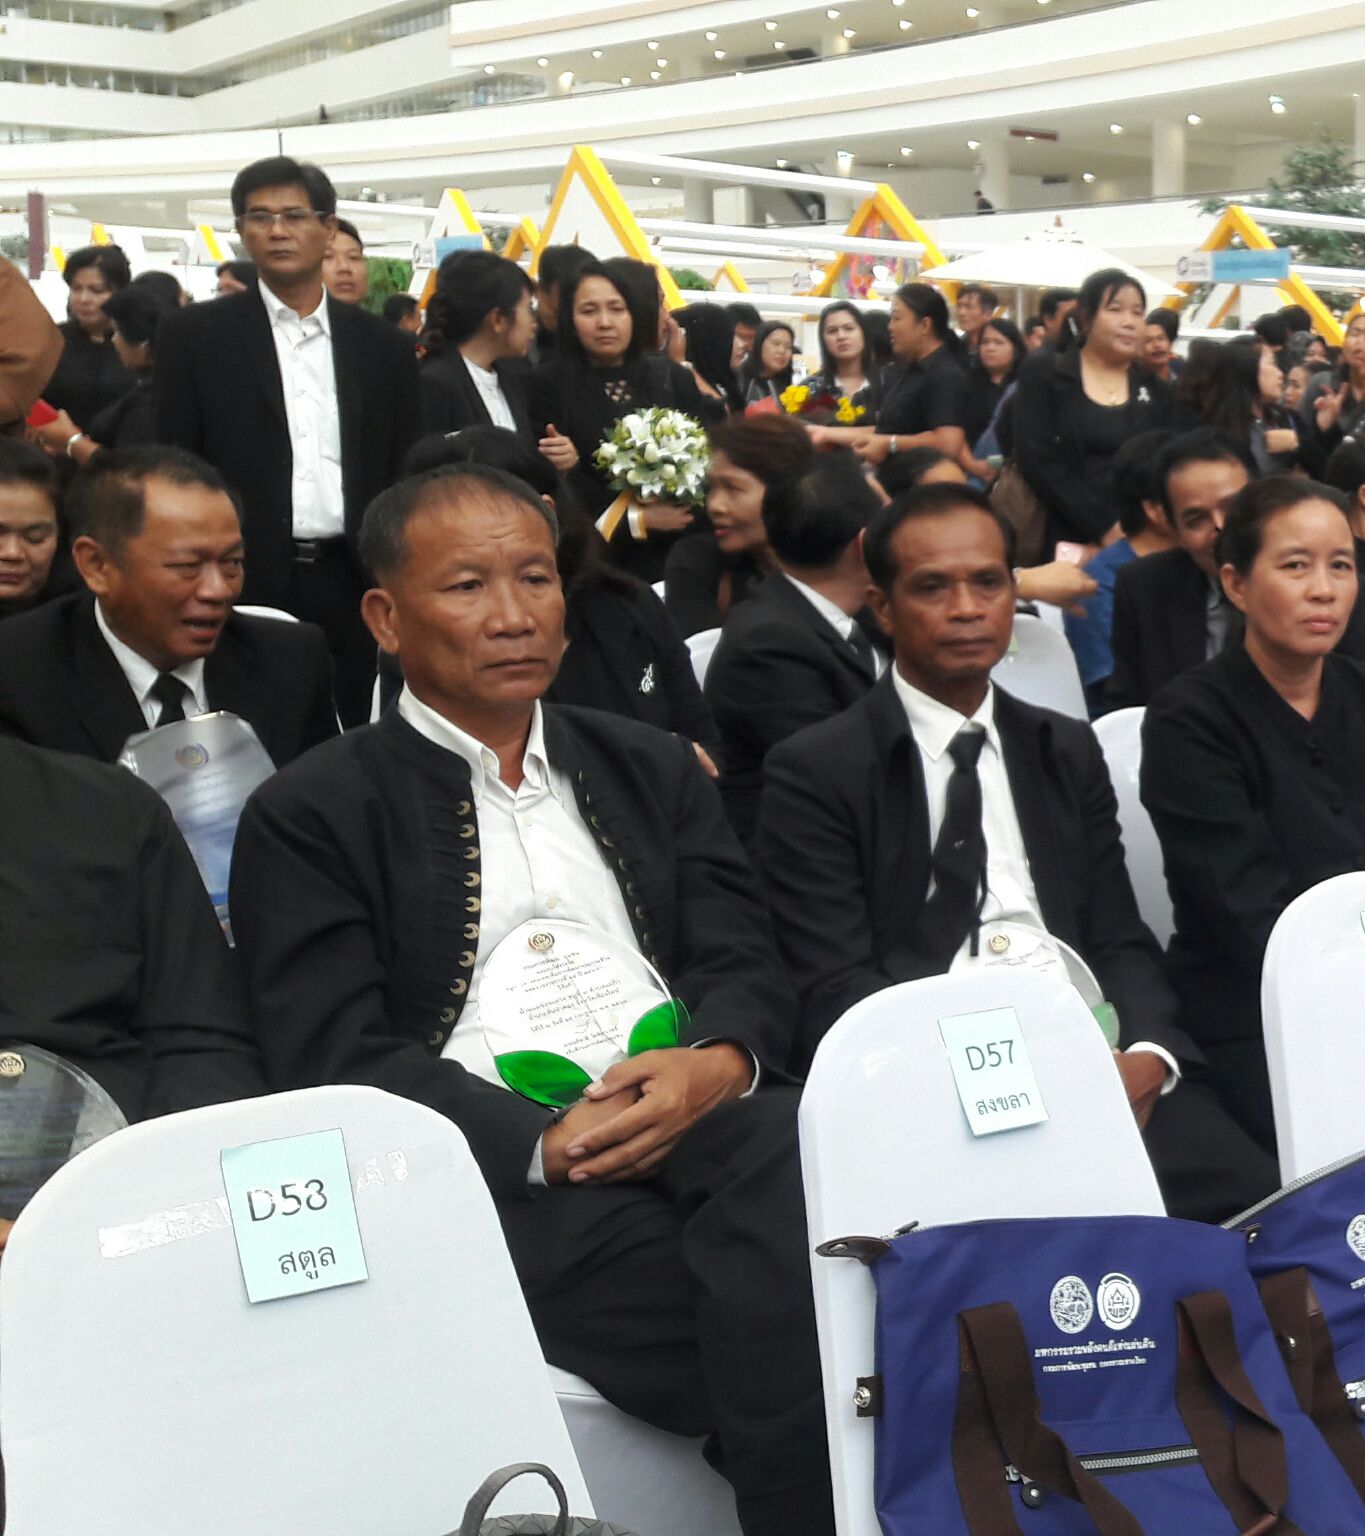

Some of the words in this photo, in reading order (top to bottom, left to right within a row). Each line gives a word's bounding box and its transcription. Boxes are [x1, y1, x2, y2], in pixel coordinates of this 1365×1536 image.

[965, 1038, 1014, 1071] D57
[975, 1092, 1031, 1116] สงขลา
[246, 1178, 328, 1222] D58
[278, 1246, 336, 1280] สตูล
